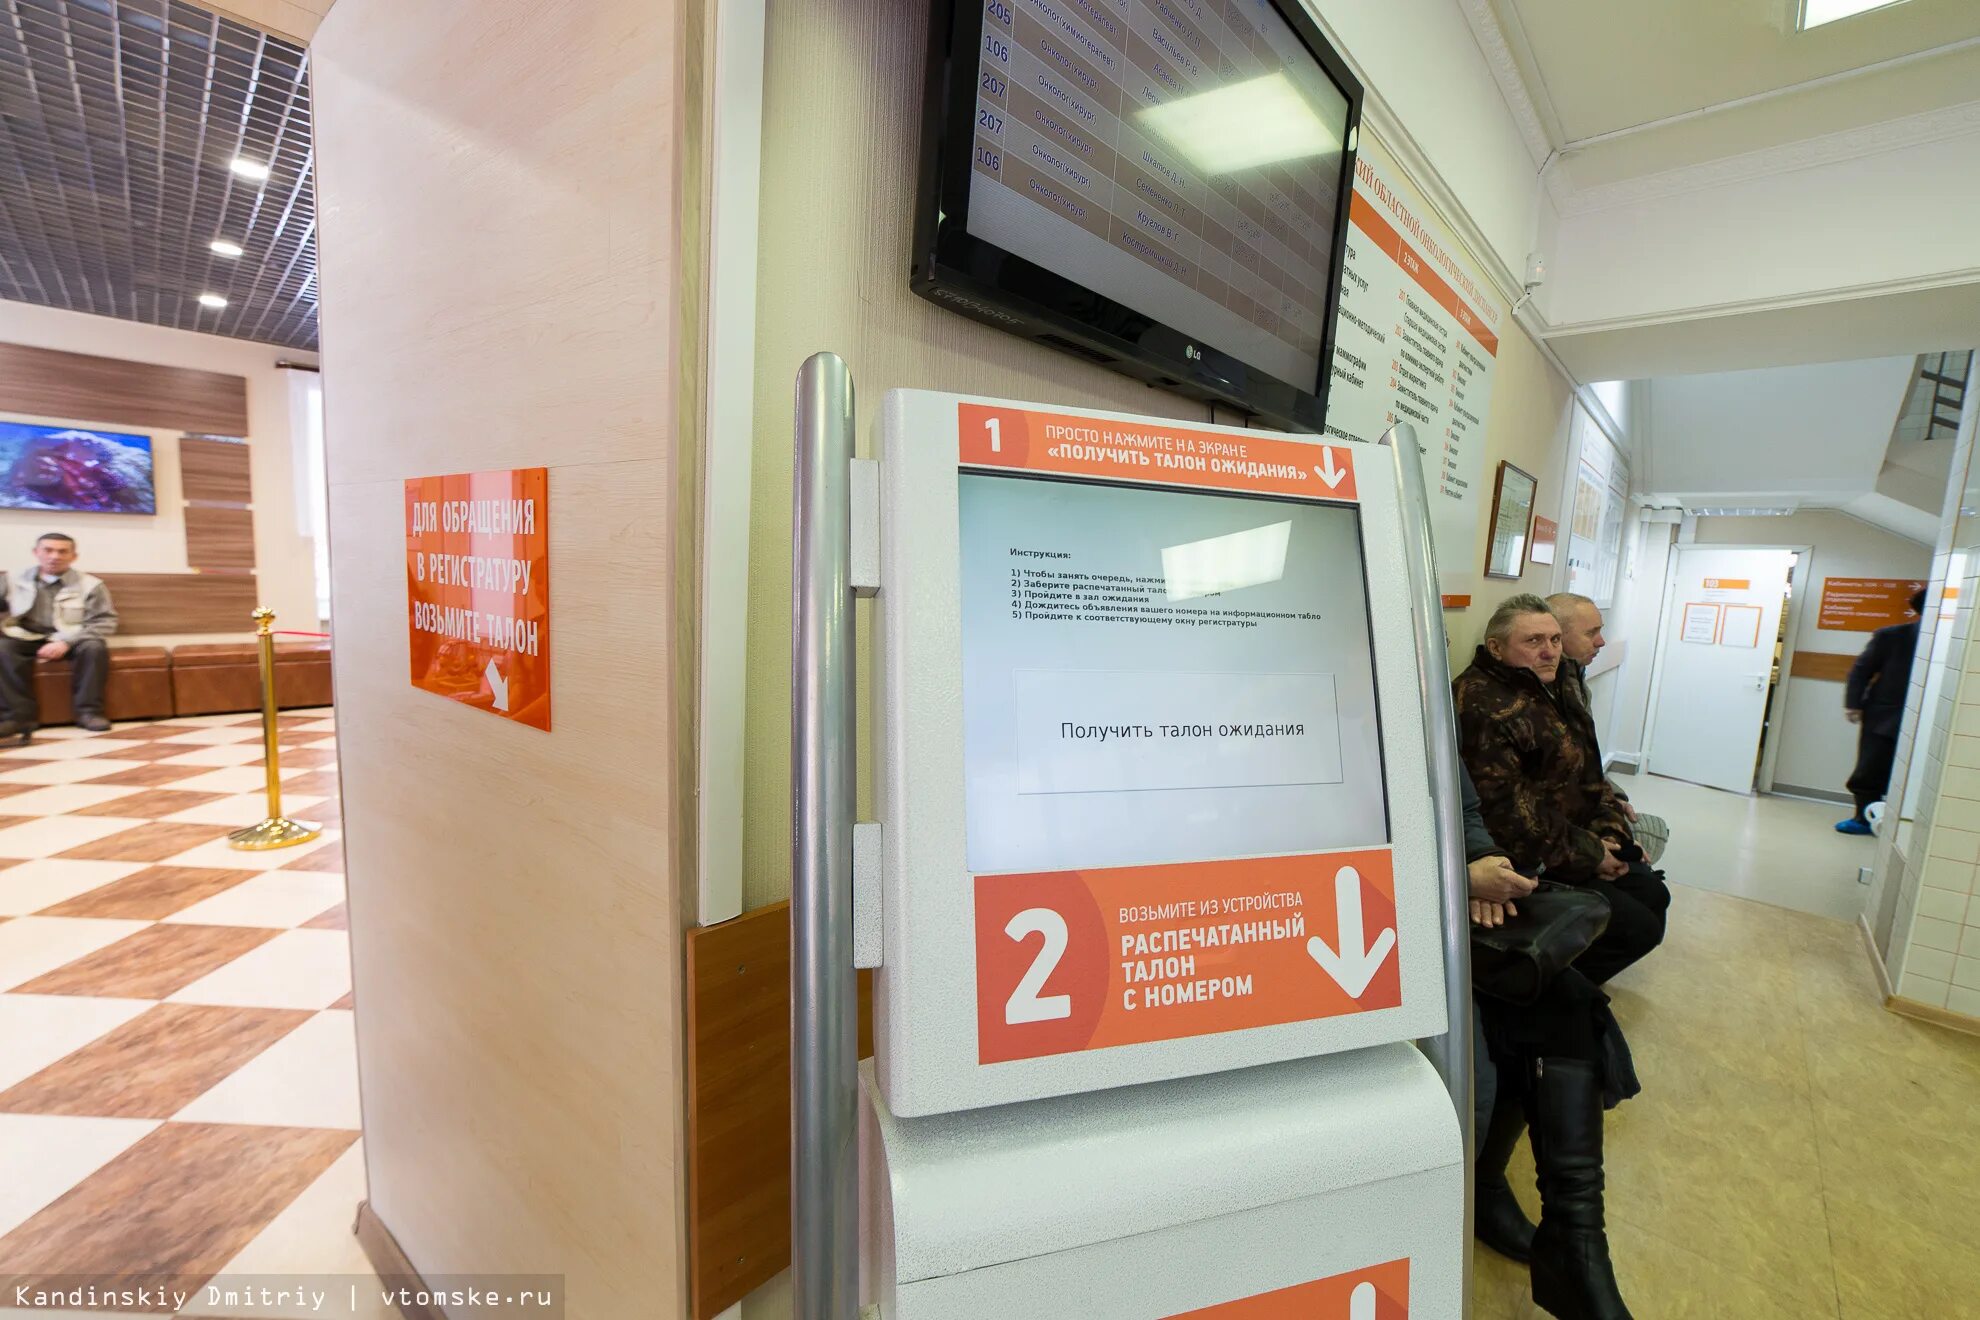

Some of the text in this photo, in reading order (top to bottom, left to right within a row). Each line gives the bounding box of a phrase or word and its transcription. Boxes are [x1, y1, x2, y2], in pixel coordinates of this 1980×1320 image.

[985, 35, 1008, 63] 106
[1029, 0, 1116, 70] нколог(химиотерапевт)
[1152, 28, 1184, 64] Васильев
[982, 72, 1006, 98] 207
[979, 109, 1003, 134] 207
[977, 147, 999, 171] 106
[1375, 178, 1420, 238] ОБЛАСТНОЙ
[984, 418, 1001, 453] 1
[1046, 424, 1247, 458] ПРОСТО НАЖМИТЕ НА ЭКРАНЕ
[1048, 443, 1308, 481] «ПОЛУЧИТЬ ТАЛОН ОЖИДАНИЯ»
[412, 499, 535, 540] ДЛЯ ОБРАЩЕНИЯ
[1010, 548, 1071, 559] Инструкция:
[417, 552, 532, 596] В РЕГИСТРАТУРУ
[1011, 569, 1165, 584] 1) Чтобы занять очередь, нажми
[1011, 579, 1021, 588] 2)
[1023, 580, 1070, 590] Заберите
[1072, 582, 1145, 593] распечатанный
[1011, 590, 1022, 598] 3)
[1024, 590, 1073, 600] Пройдите
[1102, 596, 1149, 604] ожидания
[1011, 600, 1022, 609] 4)
[1024, 601, 1080, 612] Дождитесь
[1082, 603, 1138, 613] объявления
[1140, 606, 1174, 615] вашего
[1175, 608, 1208, 616] номера
[1222, 610, 1296, 621] информационном
[414, 600, 538, 656] ВОЗЬМИТЕ ТАЛОН
[1012, 611, 1022, 619] 5)
[1025, 611, 1074, 622] Пройдите
[1084, 614, 1173, 625] соответствующему
[1175, 618, 1196, 626] окну
[1198, 619, 1258, 628] регистратуры
[1060, 722, 1305, 742] Получить талон ожидания
[1119, 890, 1303, 924] ВОЗЬМИТЕ ИЗ УСТРОЙСТВА
[1121, 912, 1305, 956] РАСПЕЧАТАННЫЙ
[1004, 907, 1071, 1026] 2
[1121, 955, 1196, 984] ТАЛОН
[1123, 974, 1253, 1010] С НОМЕРОМ
